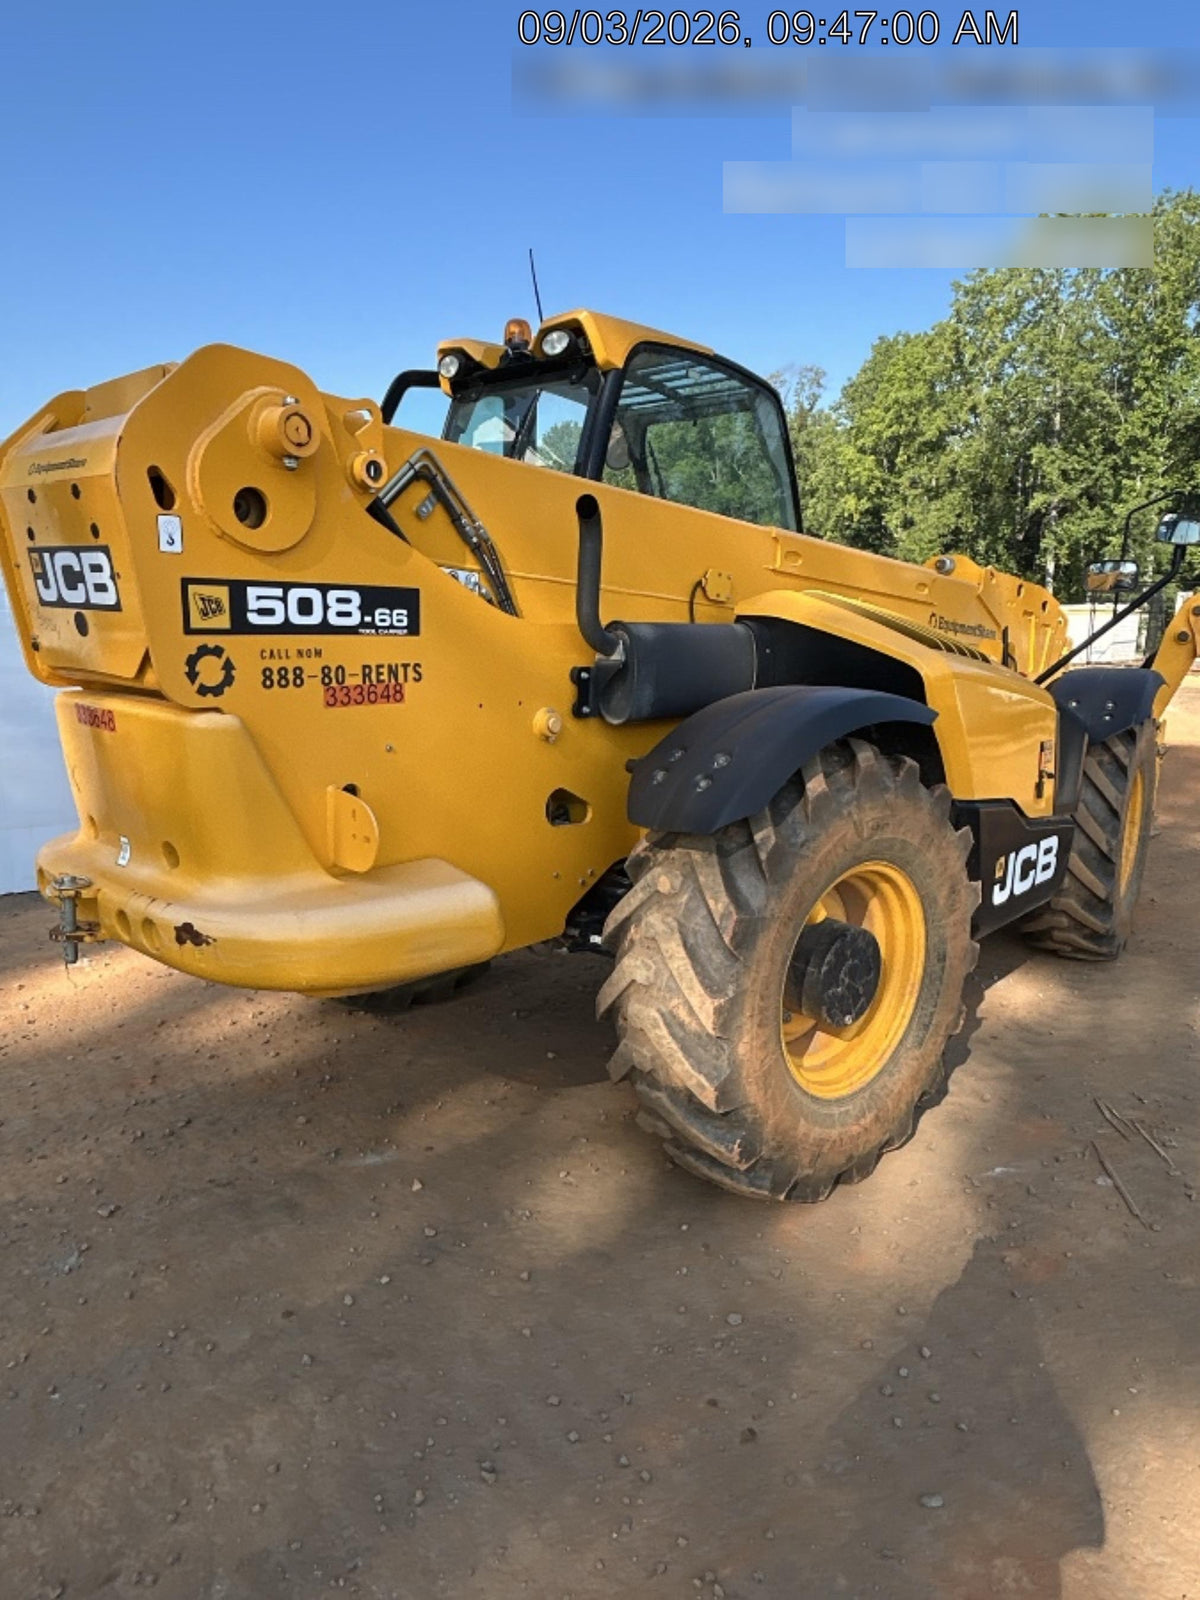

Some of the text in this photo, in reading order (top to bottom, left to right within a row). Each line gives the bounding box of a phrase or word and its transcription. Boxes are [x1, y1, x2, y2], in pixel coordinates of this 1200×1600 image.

[36, 550, 118, 605] JCB
[197, 595, 225, 619] JCB
[260, 647, 323, 660] CALL NOW
[261, 663, 422, 689] 888-80-RENTS
[325, 683, 405, 707] 333648
[992, 834, 1060, 906] JCB
